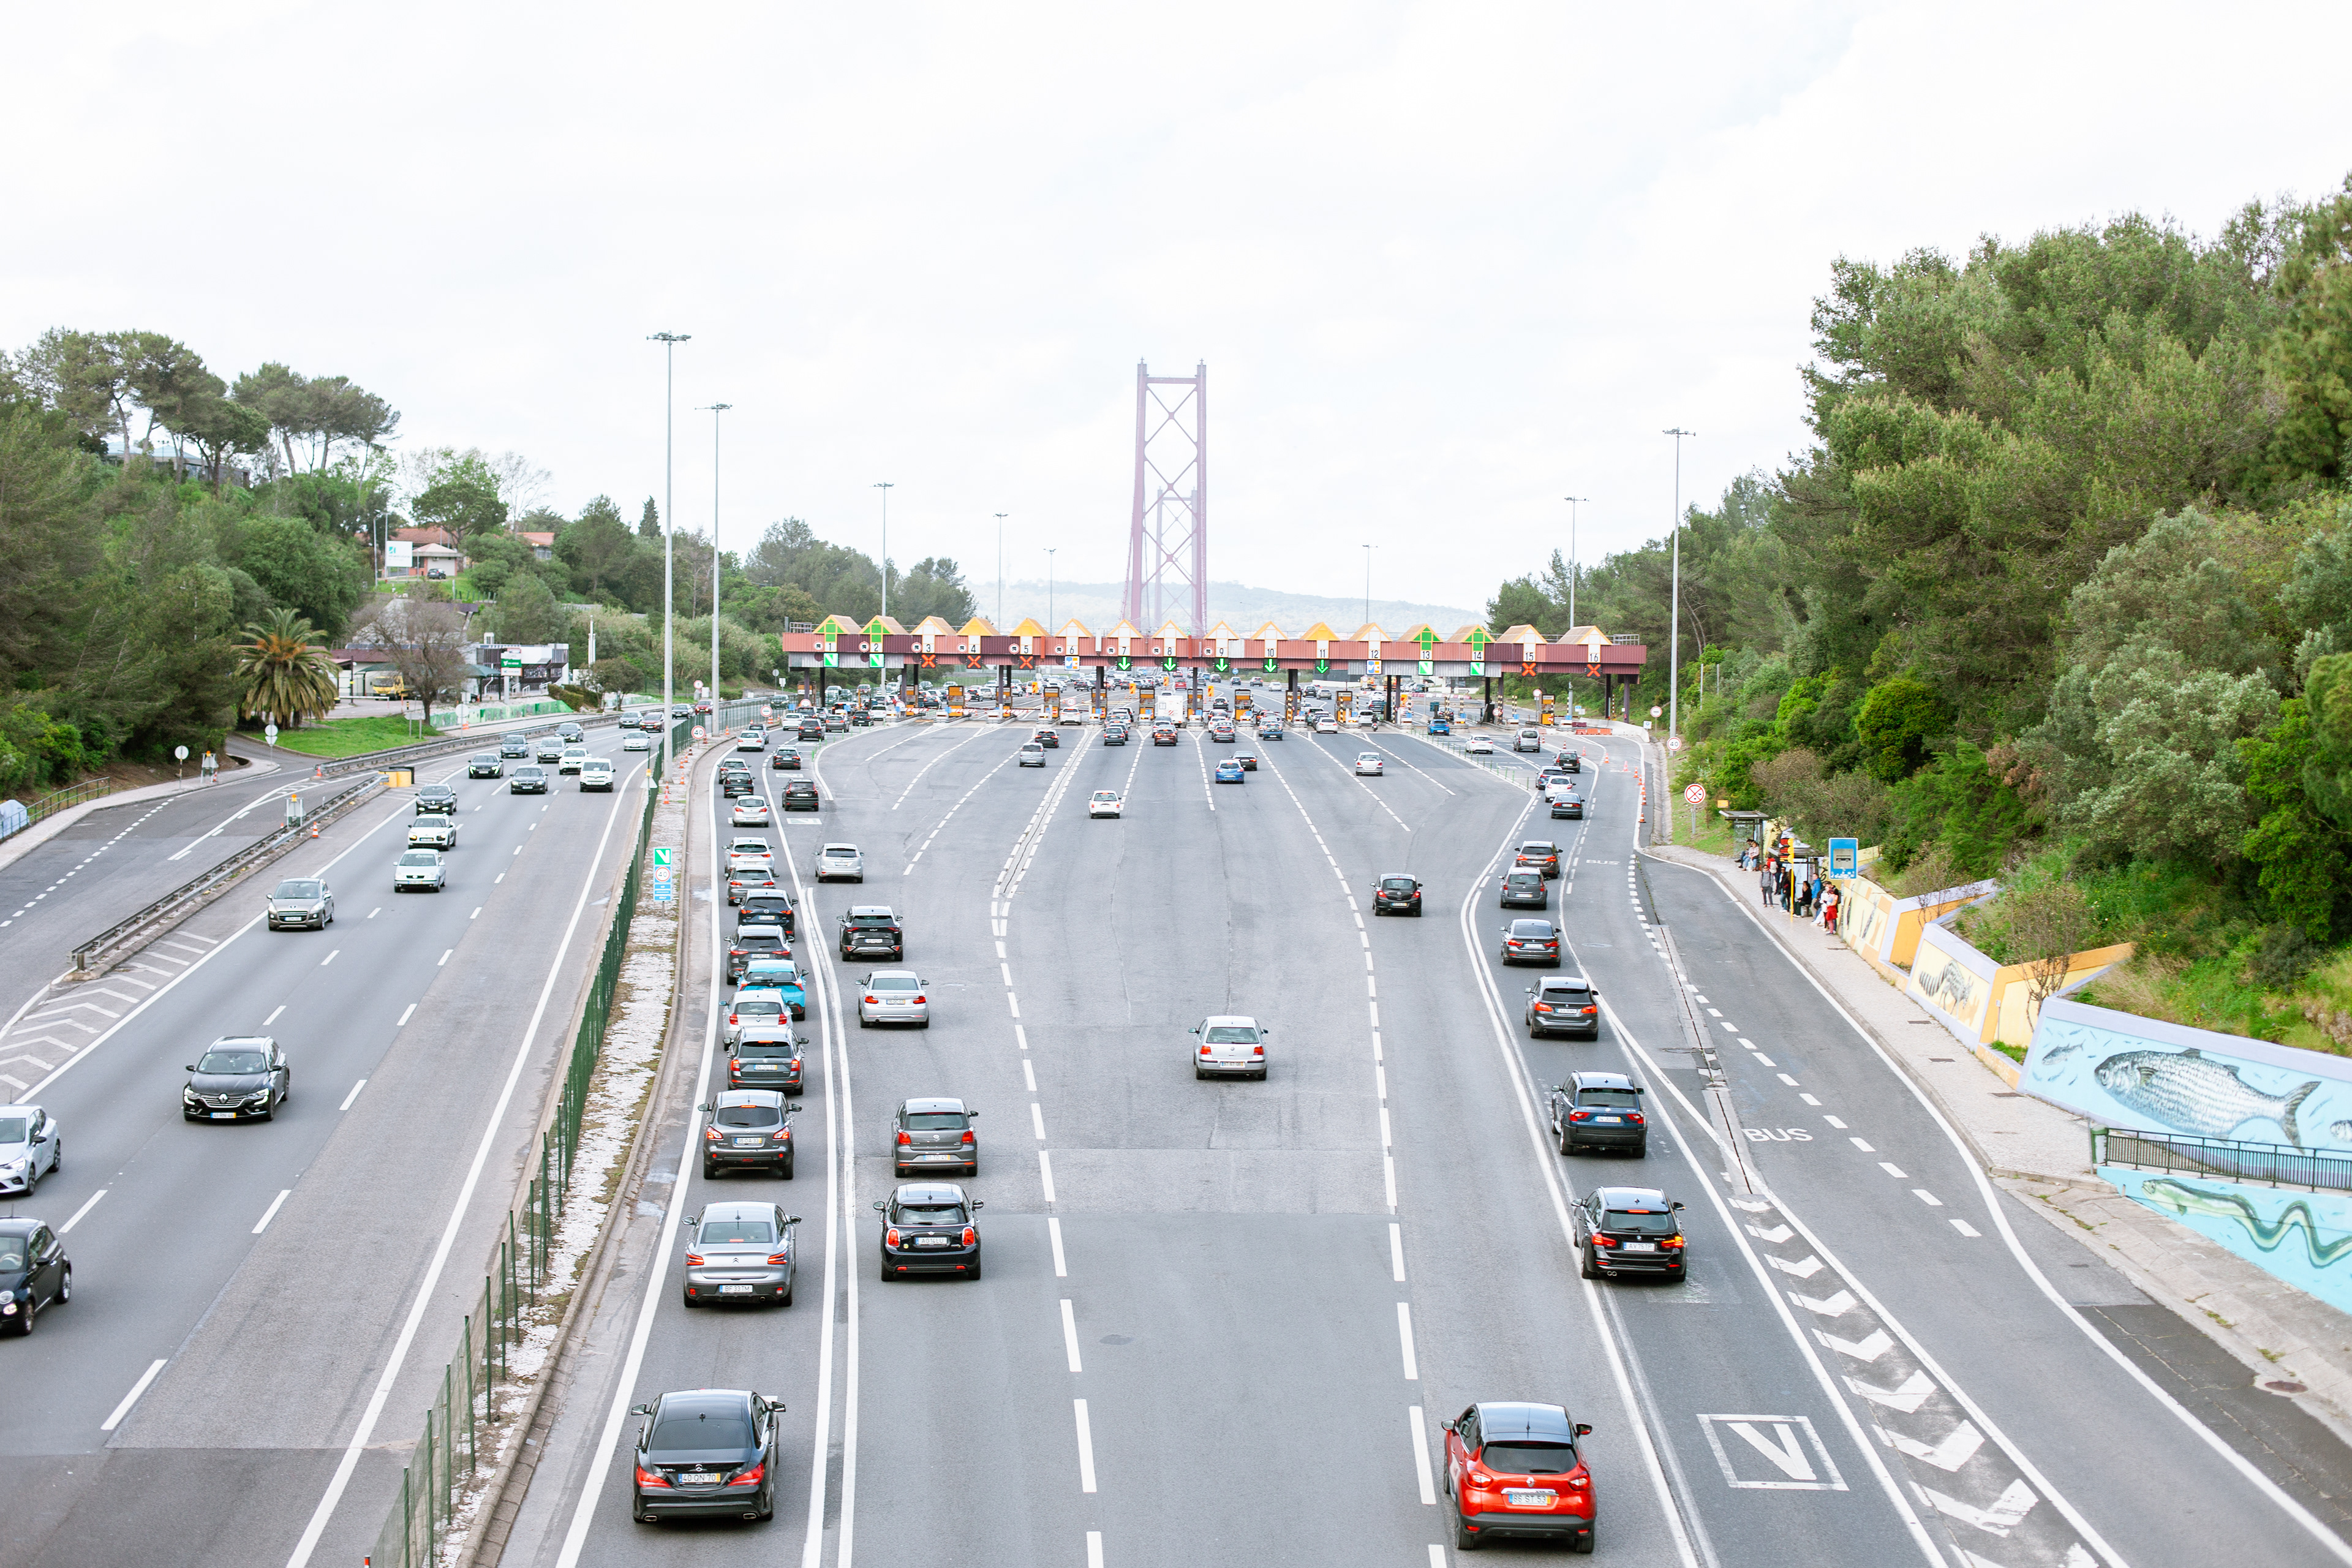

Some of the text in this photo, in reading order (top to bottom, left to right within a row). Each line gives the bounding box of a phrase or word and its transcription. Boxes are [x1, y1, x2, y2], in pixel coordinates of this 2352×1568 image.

[829, 643, 831, 651] 1
[874, 643, 878, 652] 2
[926, 644, 930, 653] 3
[971, 644, 976, 653] 4
[1024, 645, 1028, 654] 5
[1069, 646, 1074, 655] 6
[1121, 646, 1126, 655] 7
[1167, 647, 1172, 656] 8
[1219, 647, 1224, 657] 9
[1268, 648, 1274, 657] 10
[1320, 649, 1325, 658] 11
[1371, 650, 1378, 659] 12
[1422, 650, 1430, 660] 13
[1474, 651, 1482, 660] 14
[1525, 652, 1534, 661] 15
[1590, 653, 1598, 662] 16
[1743, 1127, 1813, 1142] BUS
